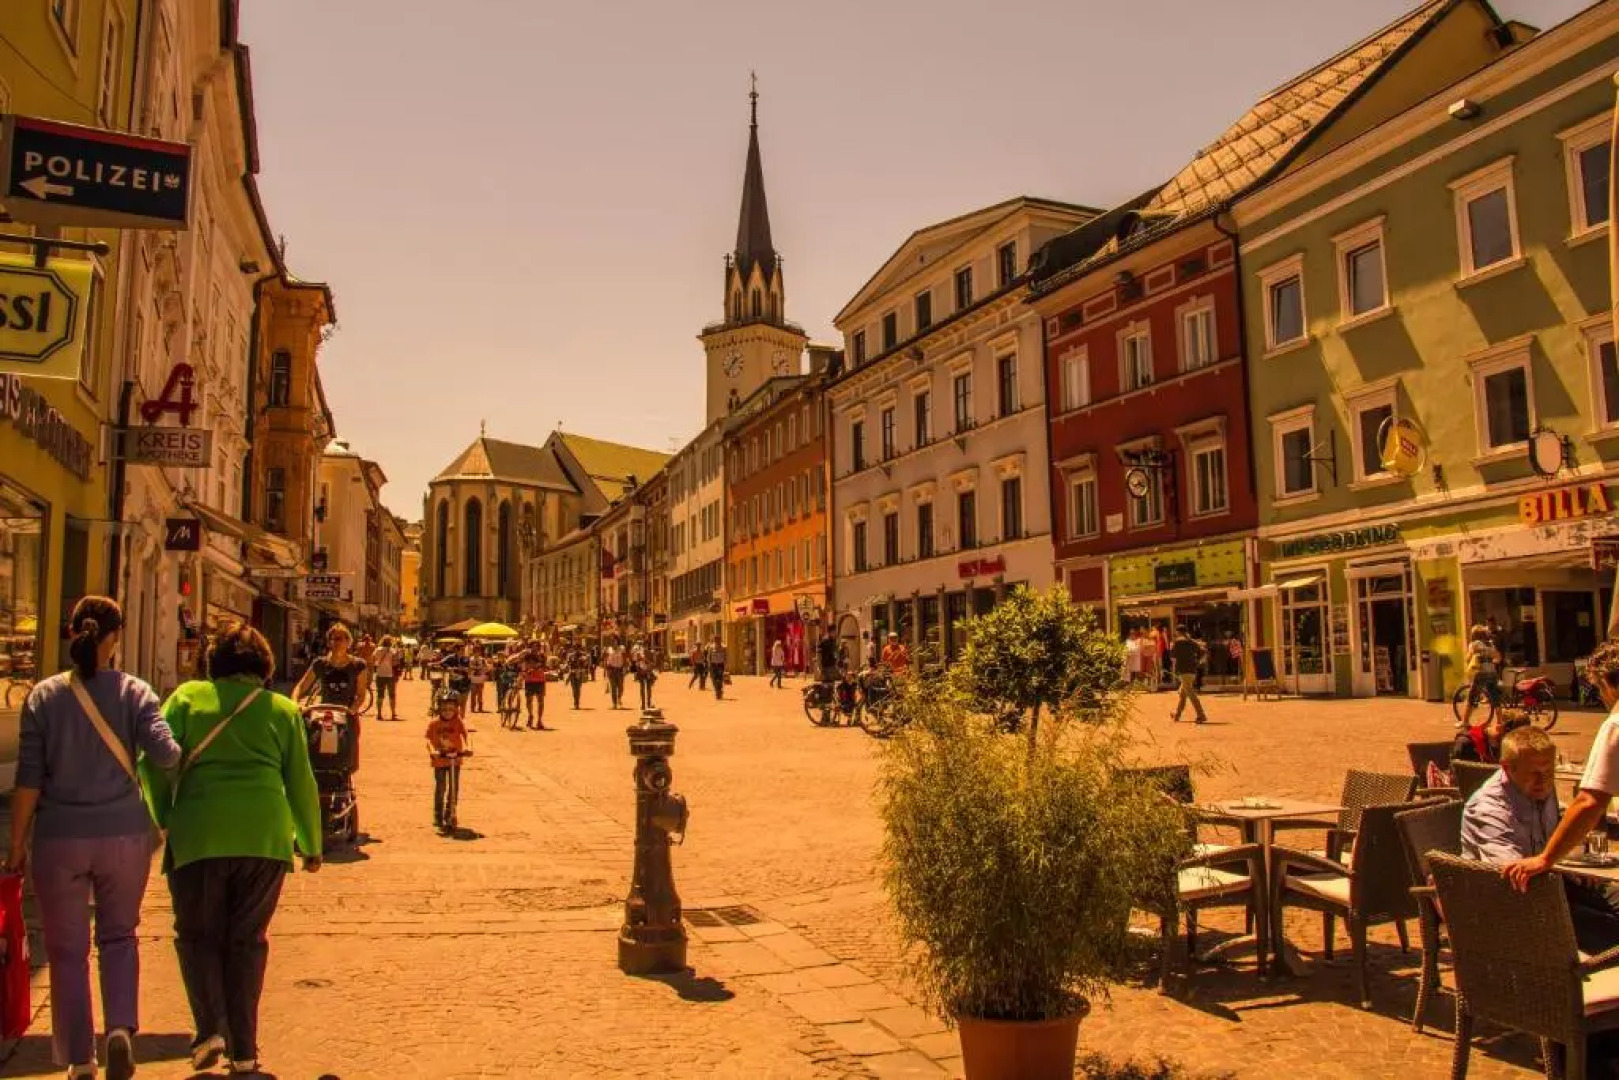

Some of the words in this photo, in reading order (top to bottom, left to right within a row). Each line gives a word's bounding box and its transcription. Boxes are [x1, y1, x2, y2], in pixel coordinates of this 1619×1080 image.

[25, 151, 160, 191] POLIZEI
[138, 431, 201, 450] KREIS
[136, 450, 200, 461] APOTHEKE
[1519, 481, 1611, 524] BILLA
